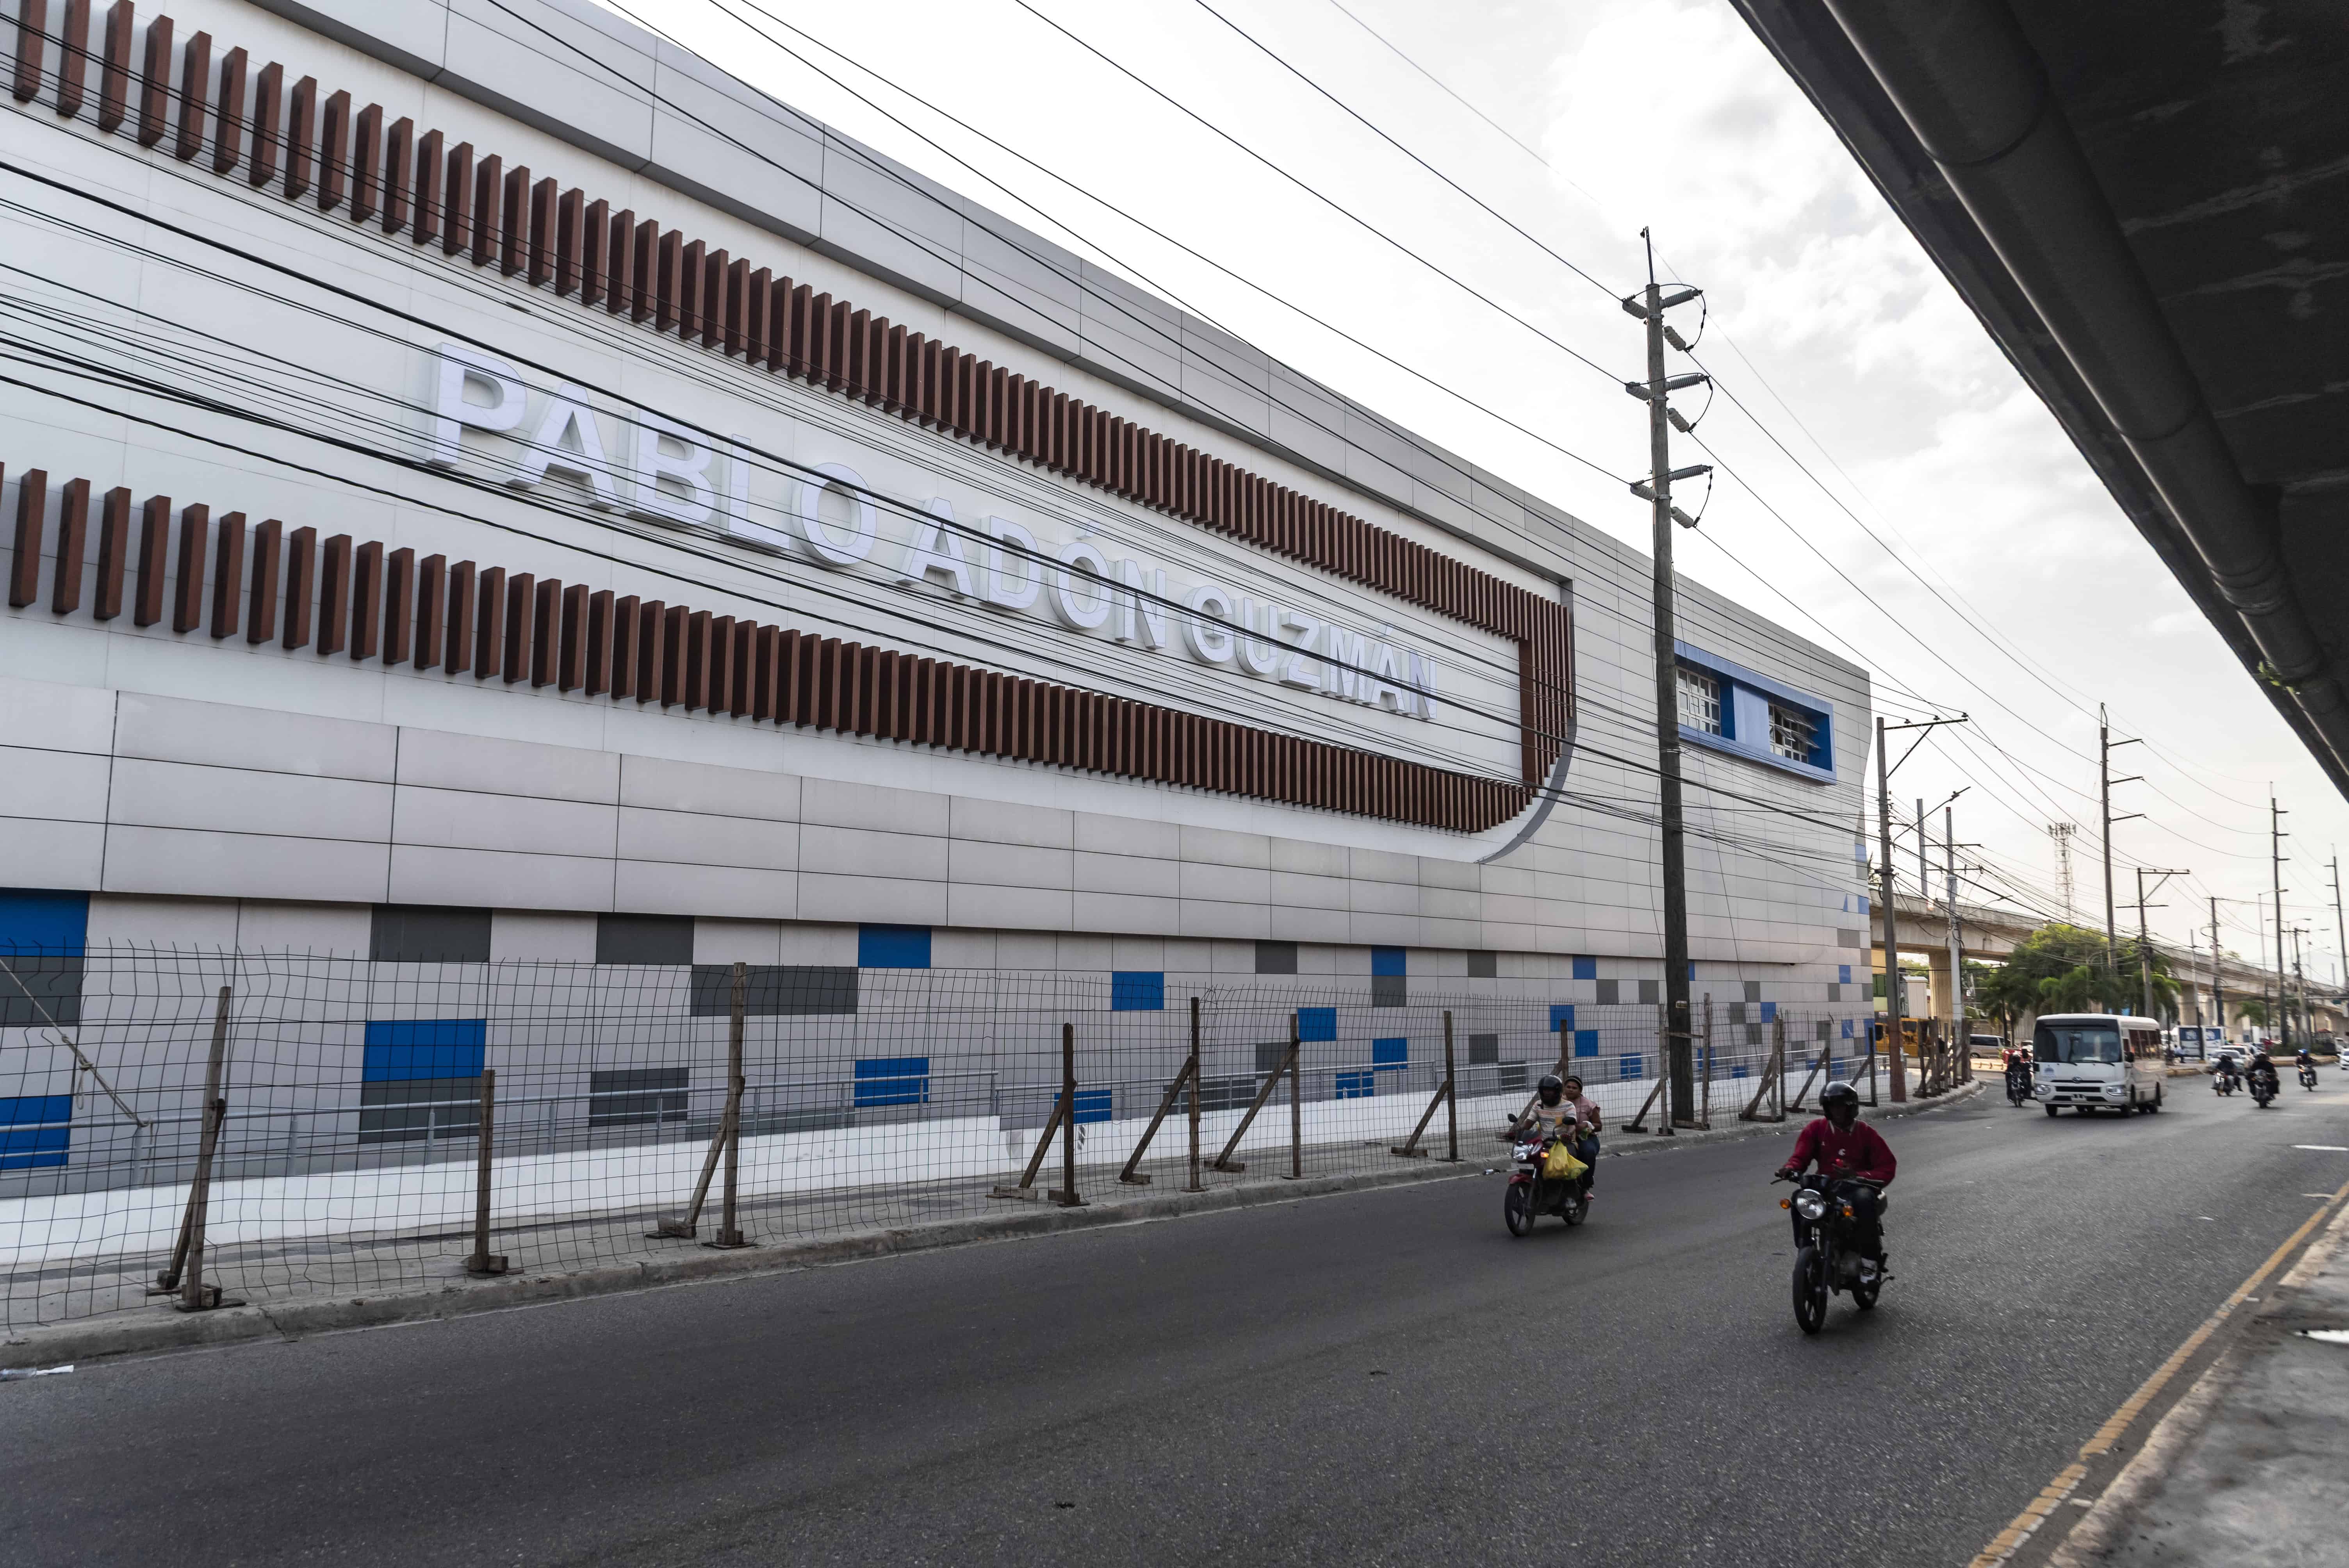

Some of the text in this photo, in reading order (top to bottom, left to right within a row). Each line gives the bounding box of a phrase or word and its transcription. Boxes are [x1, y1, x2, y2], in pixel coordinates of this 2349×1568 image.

[425, 342, 1437, 719] PABLO ADÓN GUZMÁN
